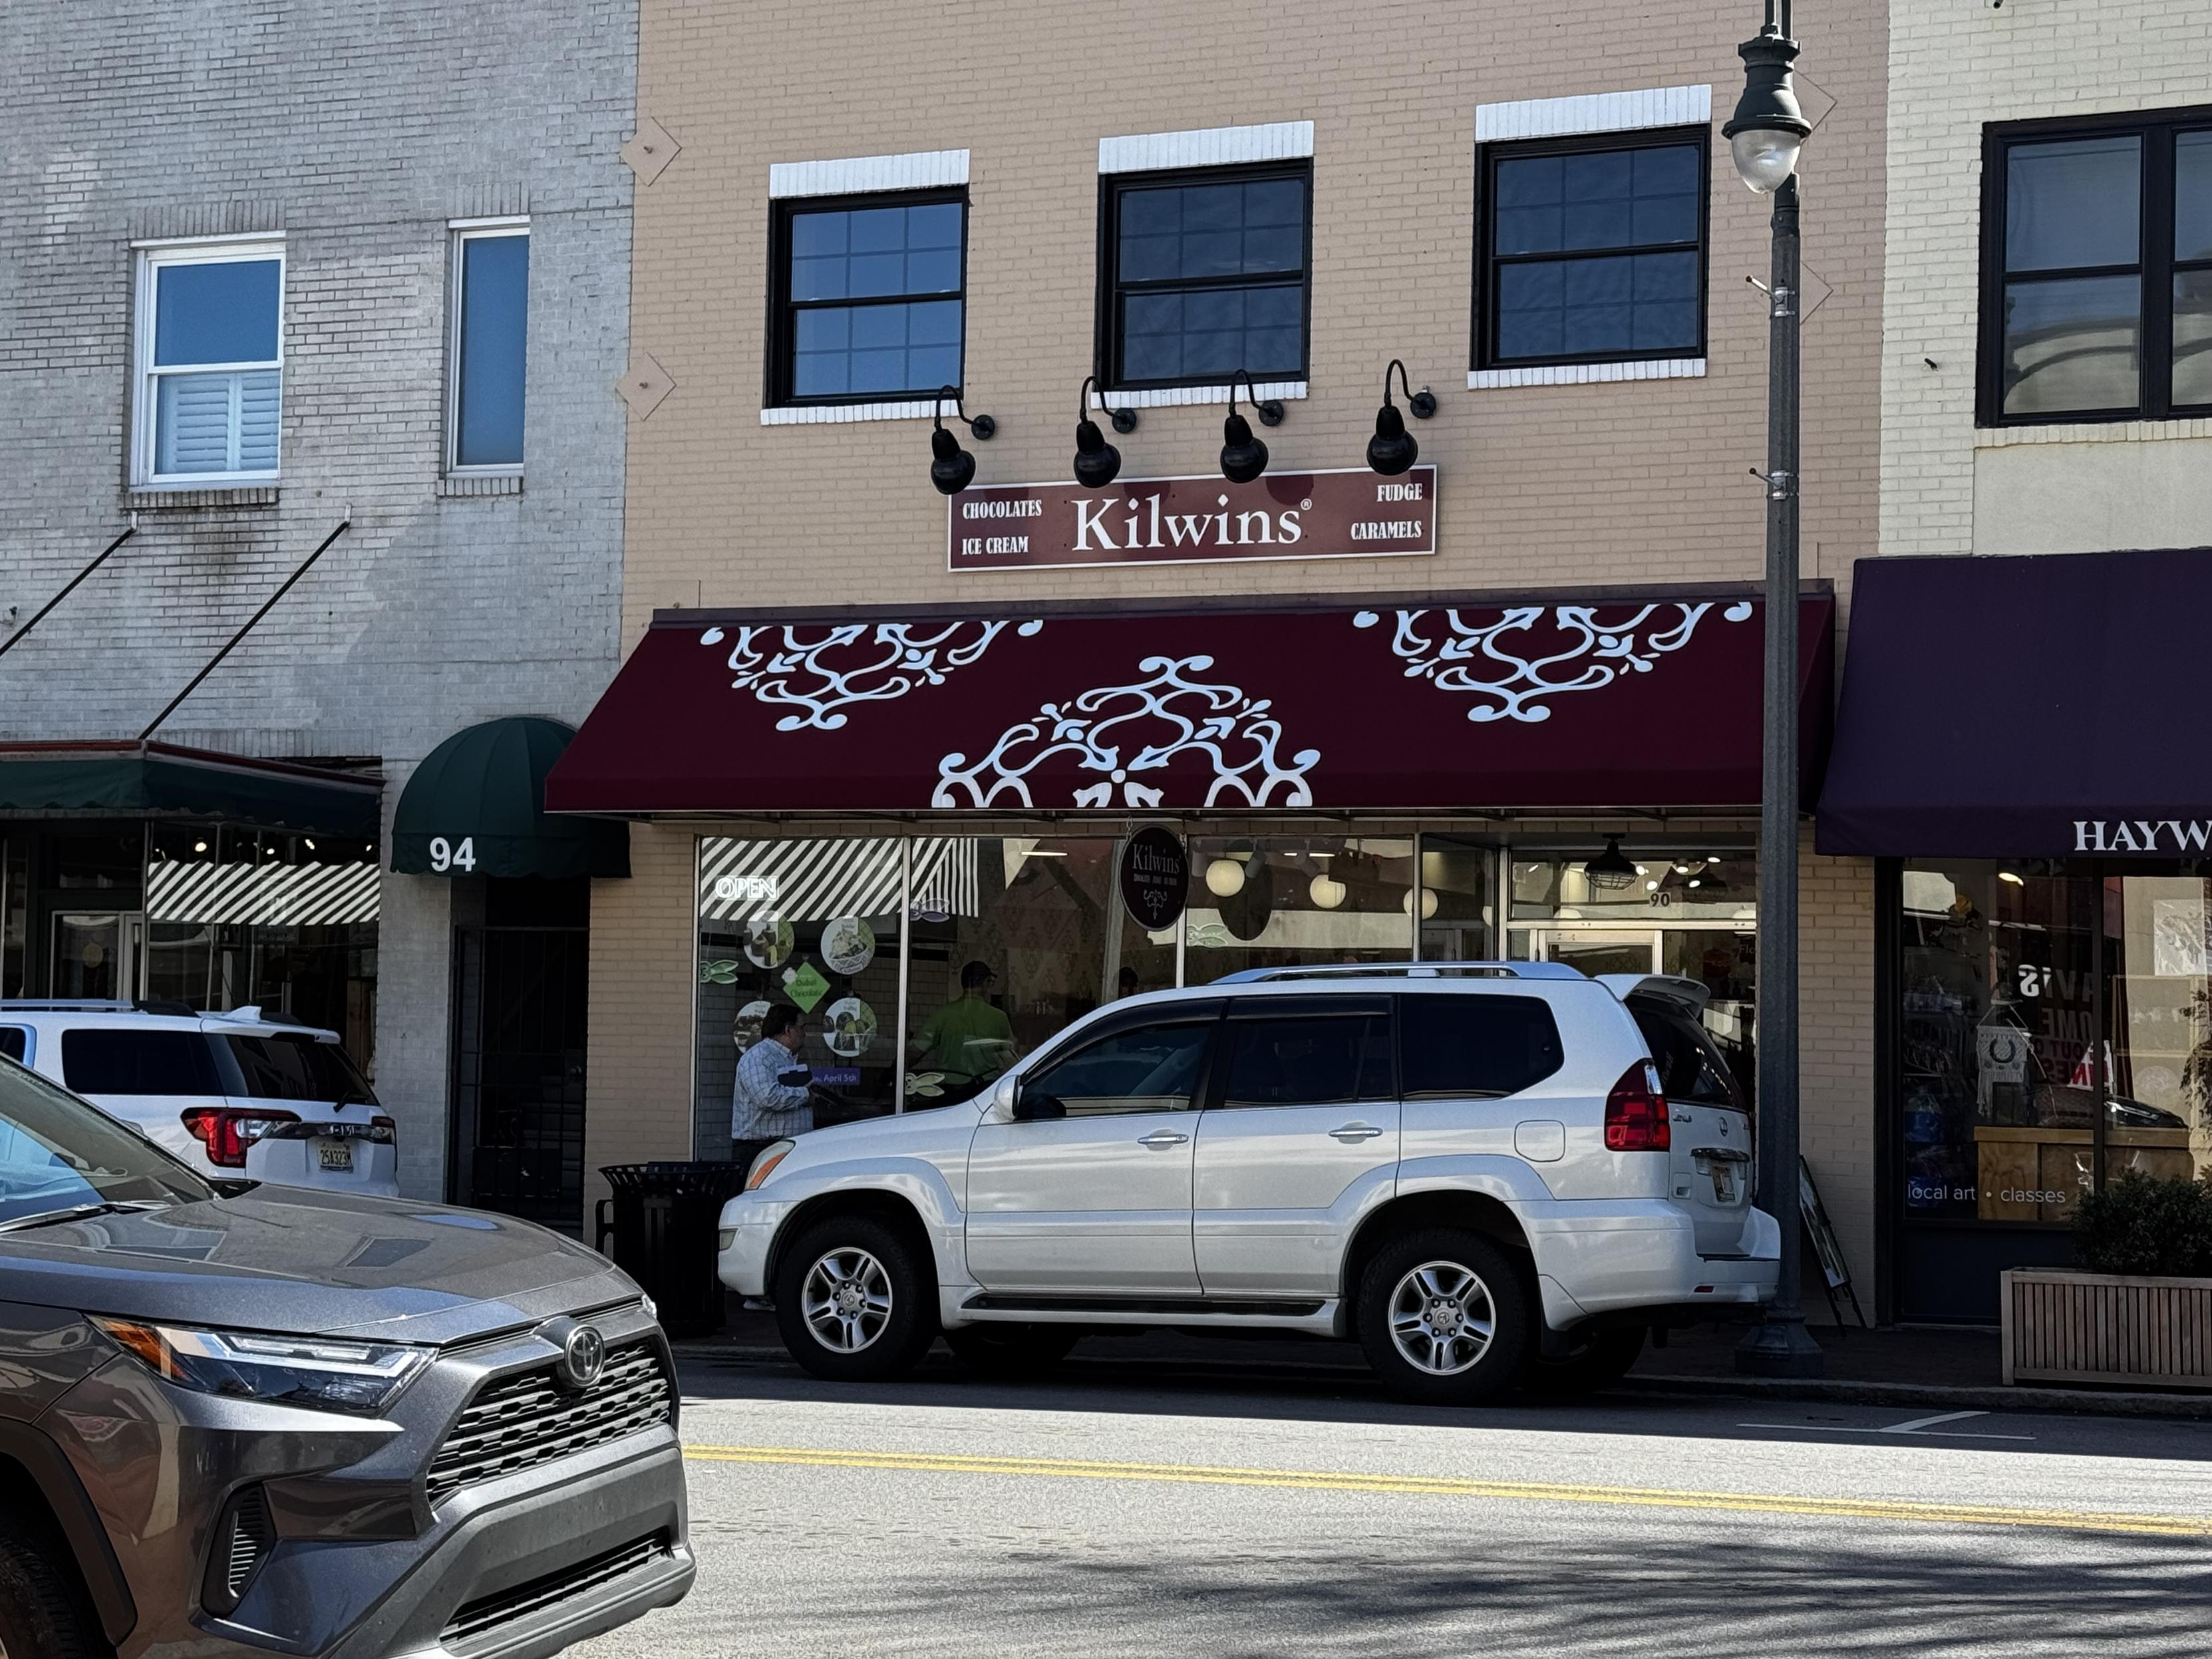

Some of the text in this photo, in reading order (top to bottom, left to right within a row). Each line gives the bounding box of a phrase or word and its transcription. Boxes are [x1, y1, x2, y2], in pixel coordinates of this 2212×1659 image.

[1376, 483, 1422, 502] FUDGE
[963, 500, 1042, 519] CHOCOLATES
[1350, 520, 1422, 540] CARAMELS
[961, 535, 1028, 555] ICE CREAM
[430, 837, 476, 872] 94
[1132, 843, 1180, 875] Kilwins
[714, 877, 777, 899] OPEN
[1651, 893, 1670, 907] 90
[824, 1074, 842, 1084] April
[1907, 1183, 2066, 1203] local art classes
